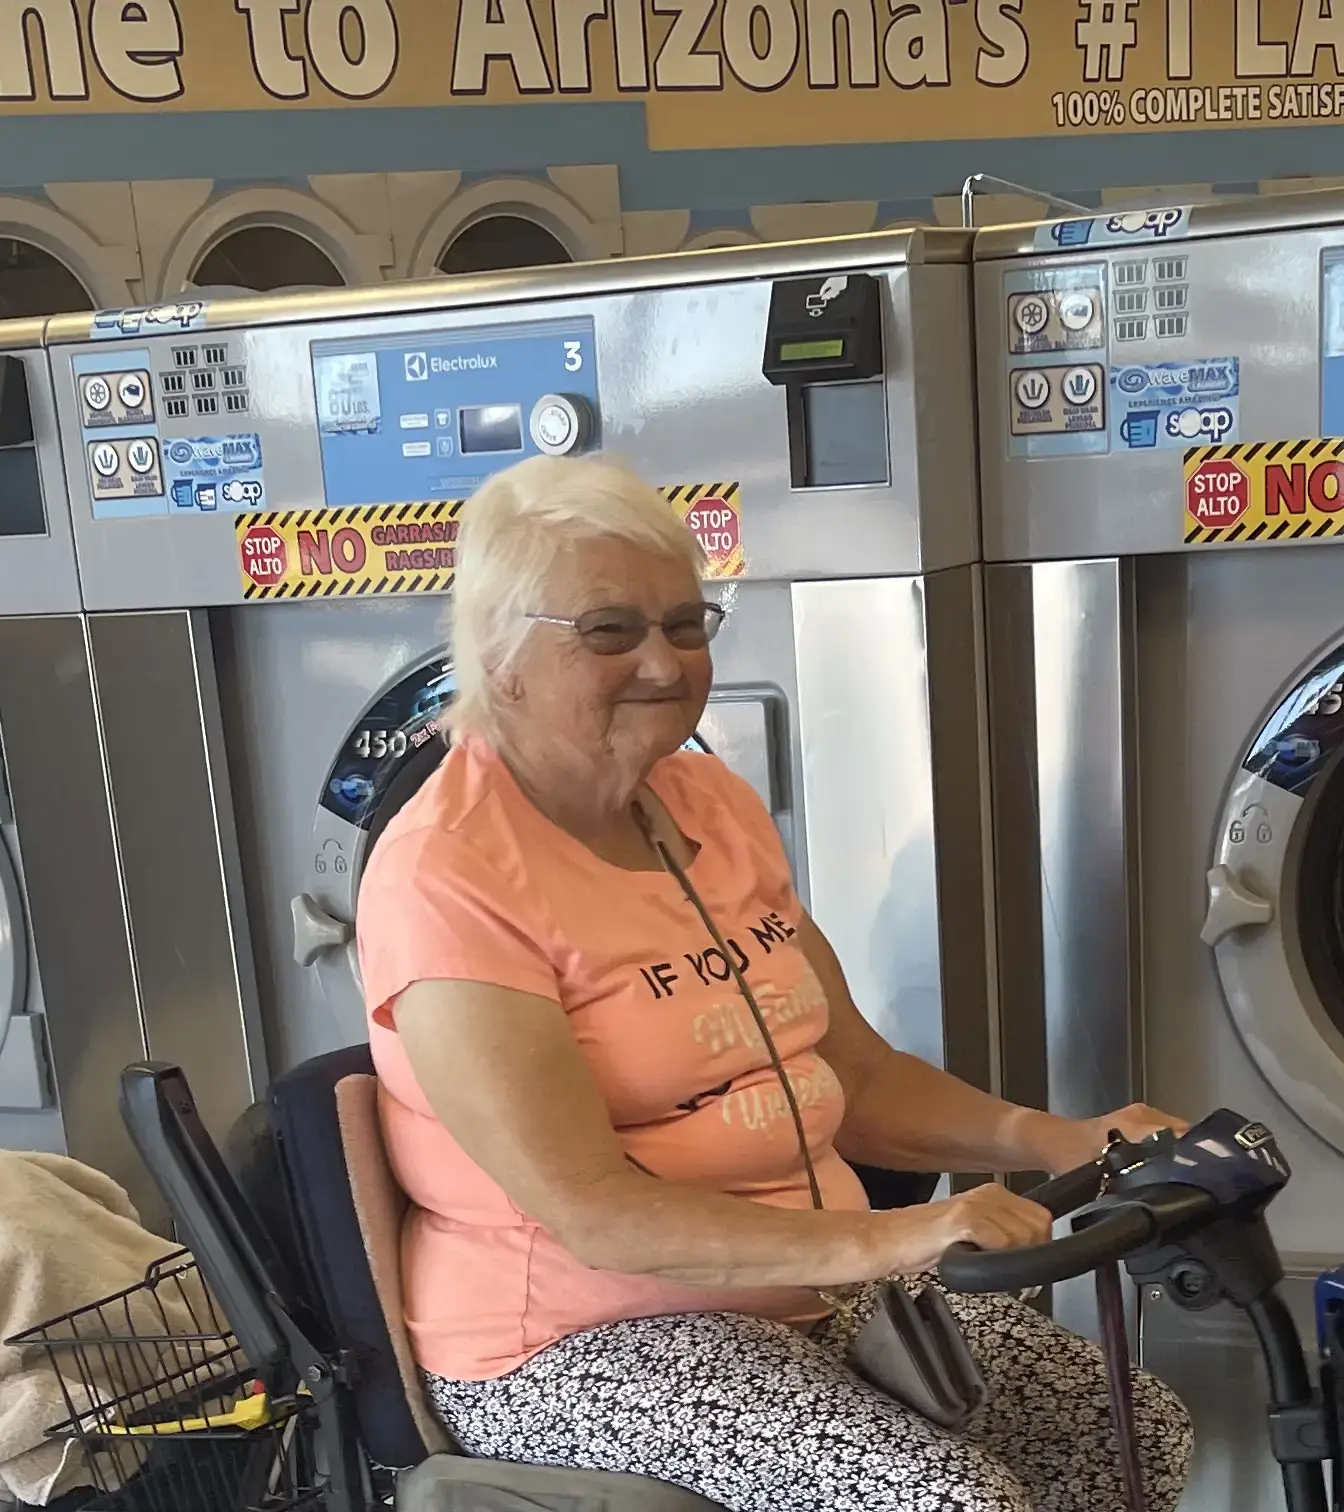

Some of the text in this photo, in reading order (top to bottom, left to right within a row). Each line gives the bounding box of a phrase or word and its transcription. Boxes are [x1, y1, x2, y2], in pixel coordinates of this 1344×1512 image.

[235, 0, 400, 100] to
[451, 0, 1029, 94] Arizonas
[1075, 0, 1192, 82] #1
[1052, 90, 1125, 127] 100%
[1130, 85, 1261, 124] COMPLETE
[430, 353, 498, 373] Electrolux
[563, 341, 583, 371] 3
[1166, 406, 1233, 443] soap
[1194, 471, 1241, 495] STOP
[690, 509, 733, 530] STOP
[1196, 496, 1241, 518] ALTO
[244, 537, 281, 556] STOP
[297, 527, 367, 576] NO
[249, 558, 283, 576] ALTO
[355, 730, 406, 758] 450
[640, 963, 678, 999] IF
[684, 939, 750, 986] YOU
